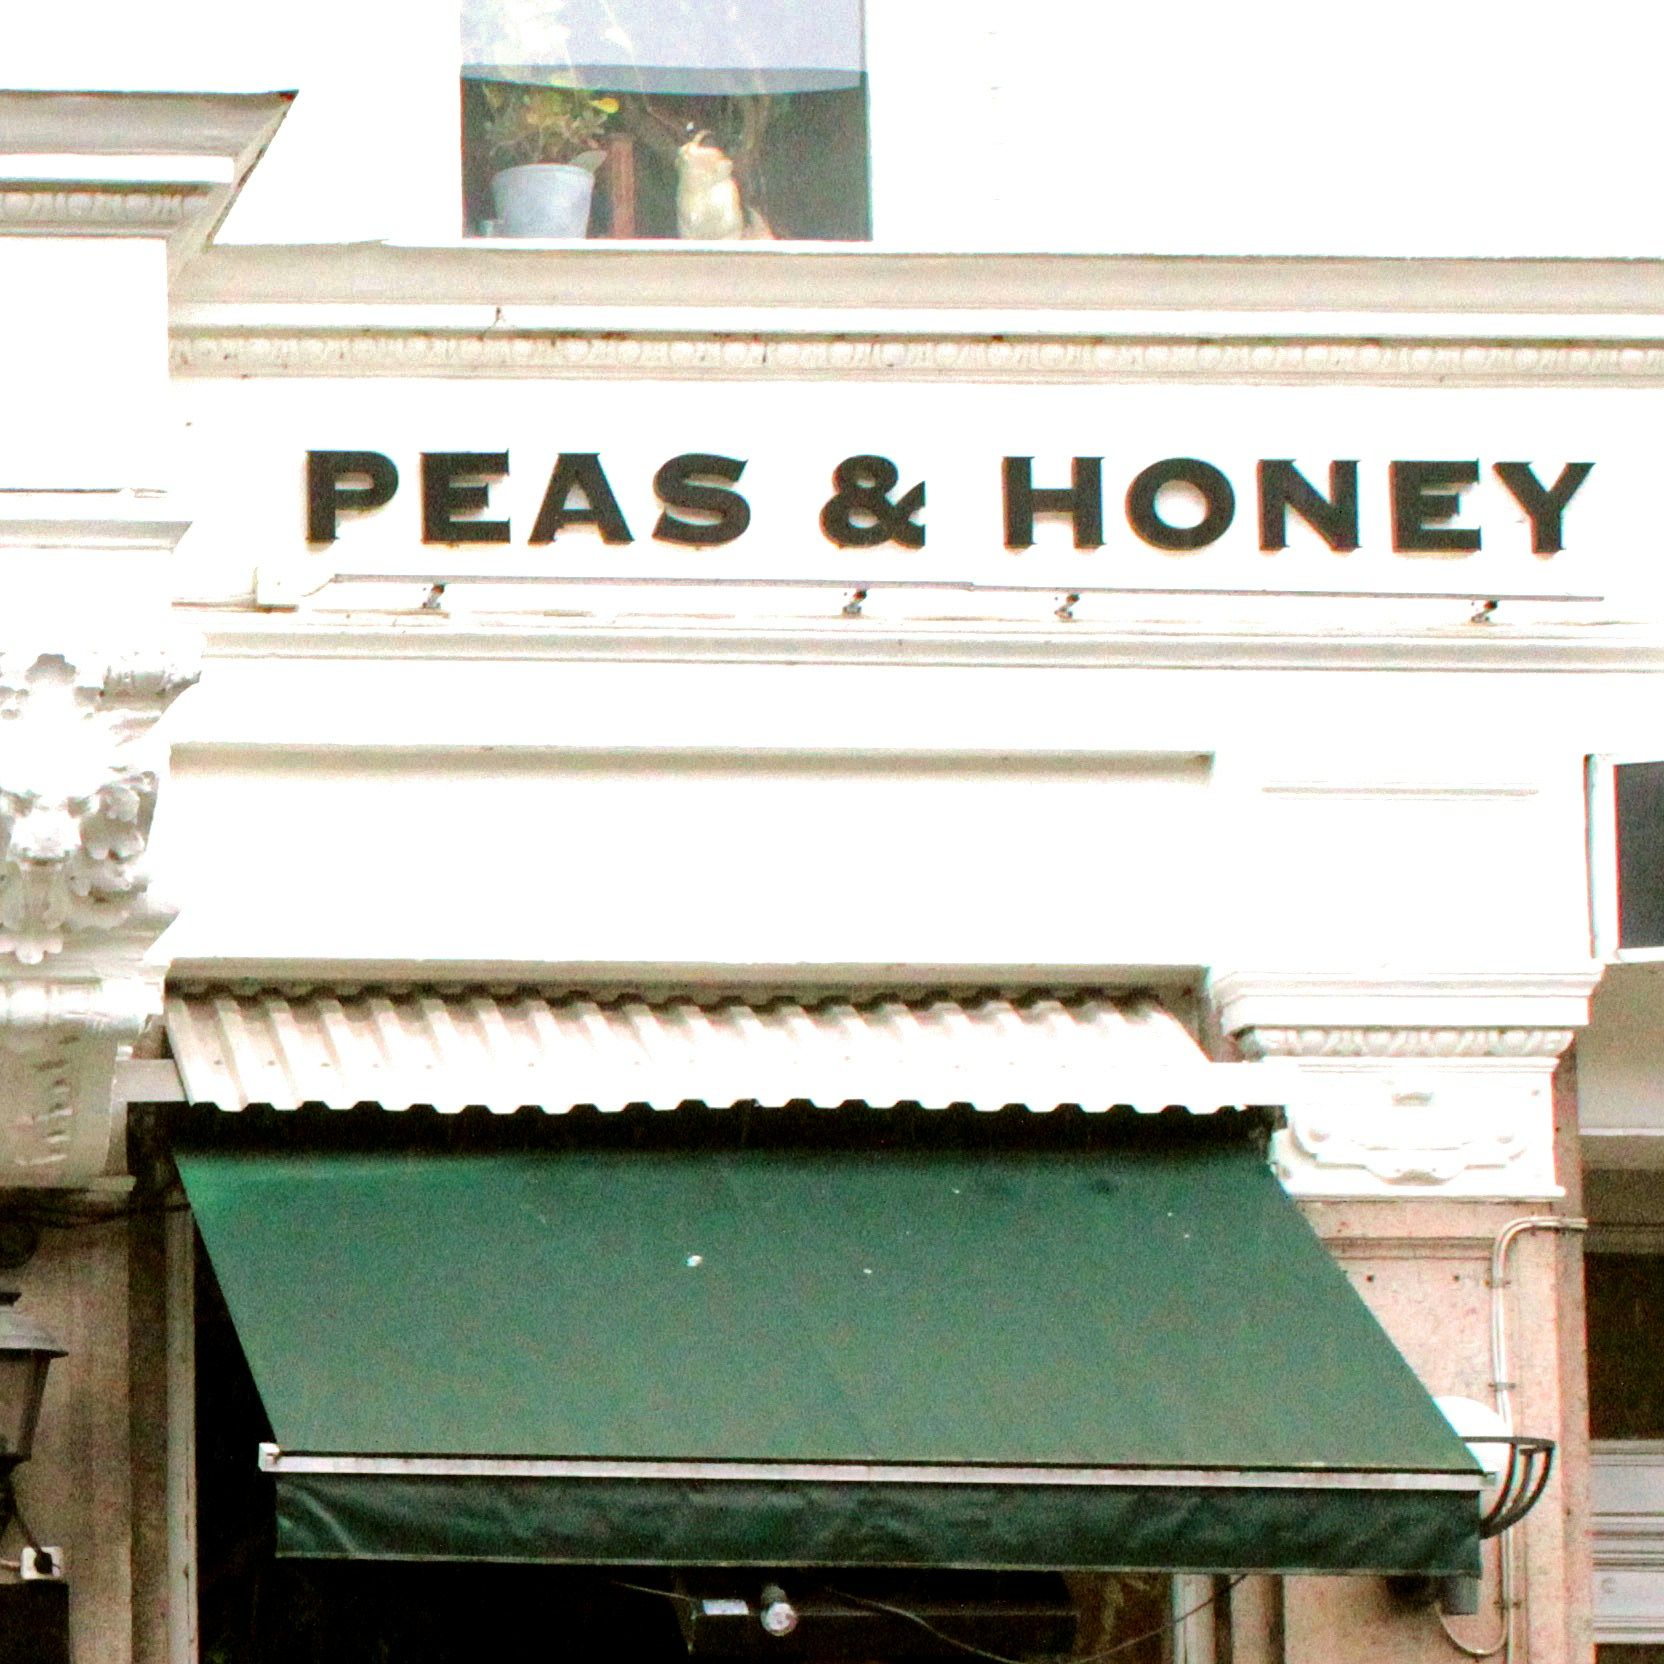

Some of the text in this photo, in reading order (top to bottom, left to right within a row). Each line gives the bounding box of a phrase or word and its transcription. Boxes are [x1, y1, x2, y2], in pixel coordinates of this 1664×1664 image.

[305, 449, 1596, 554] PEAS & HONEY
